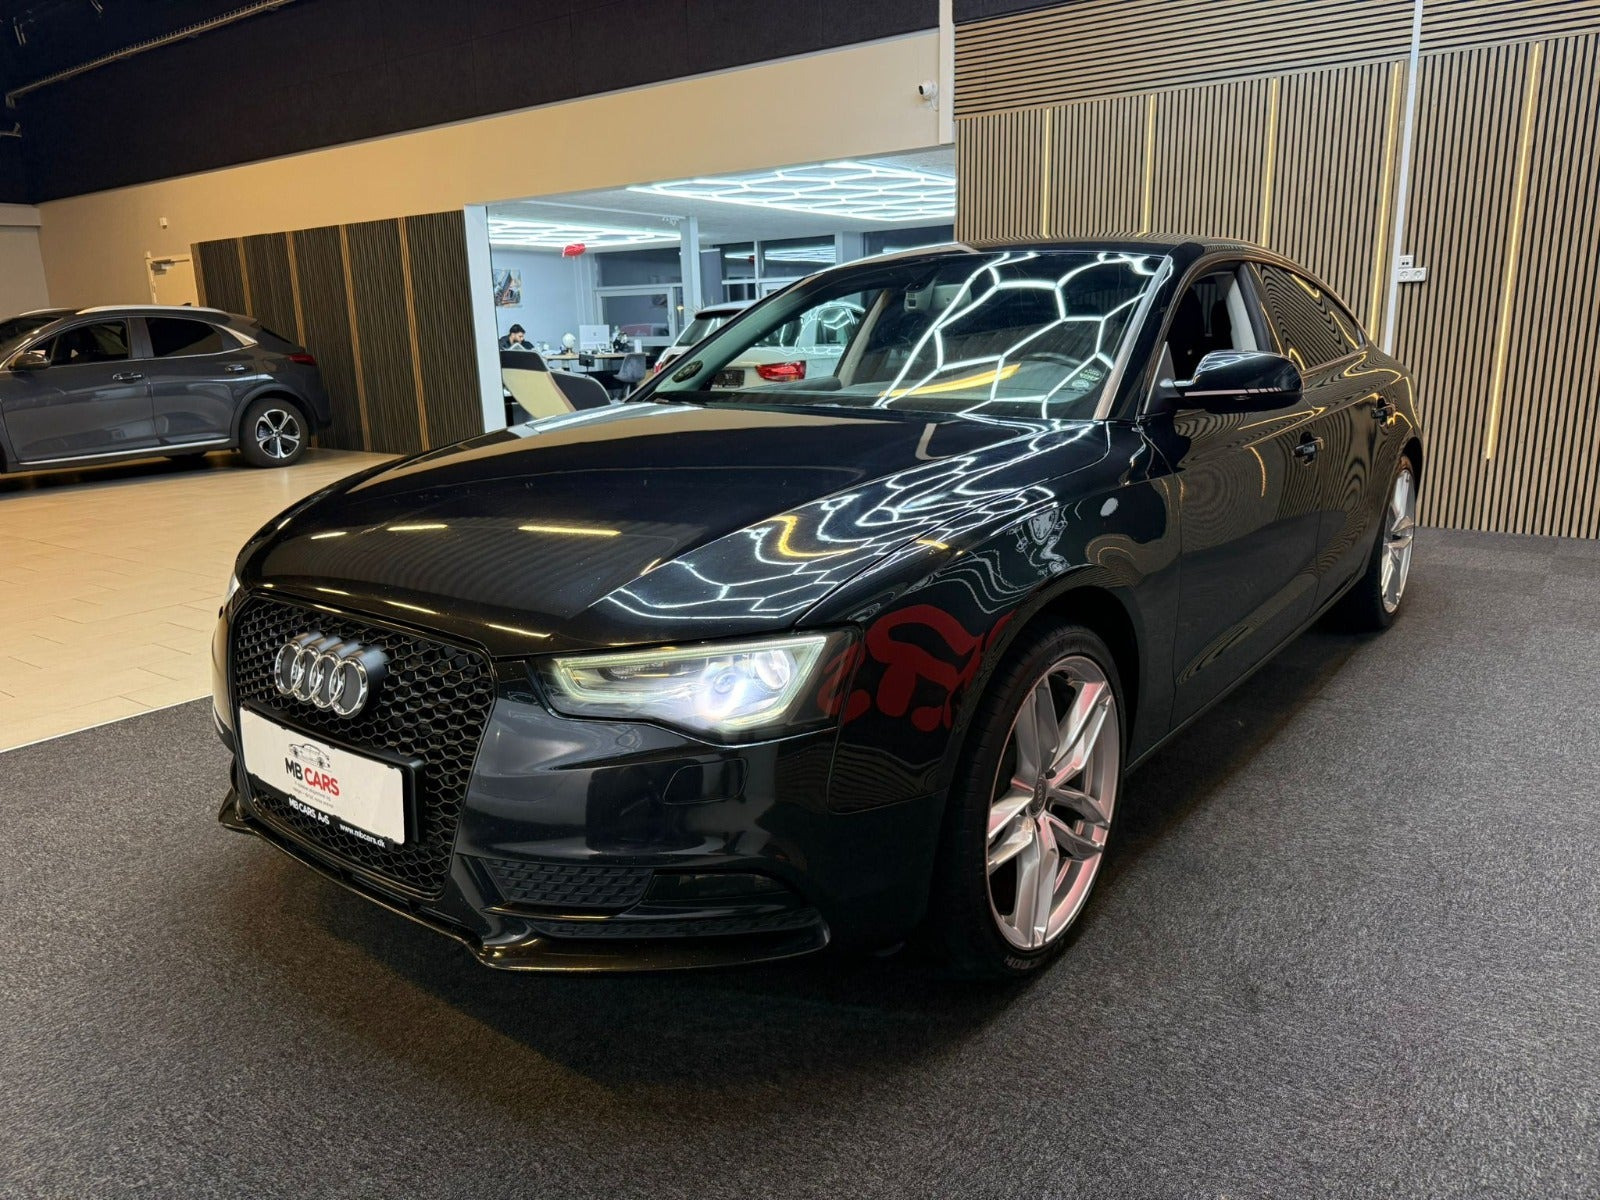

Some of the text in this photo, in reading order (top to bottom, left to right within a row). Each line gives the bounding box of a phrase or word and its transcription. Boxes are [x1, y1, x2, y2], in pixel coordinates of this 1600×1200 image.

[285, 757, 303, 781] MB
[304, 767, 340, 796] CARS
[339, 823, 386, 848] www.mbcars.dk
